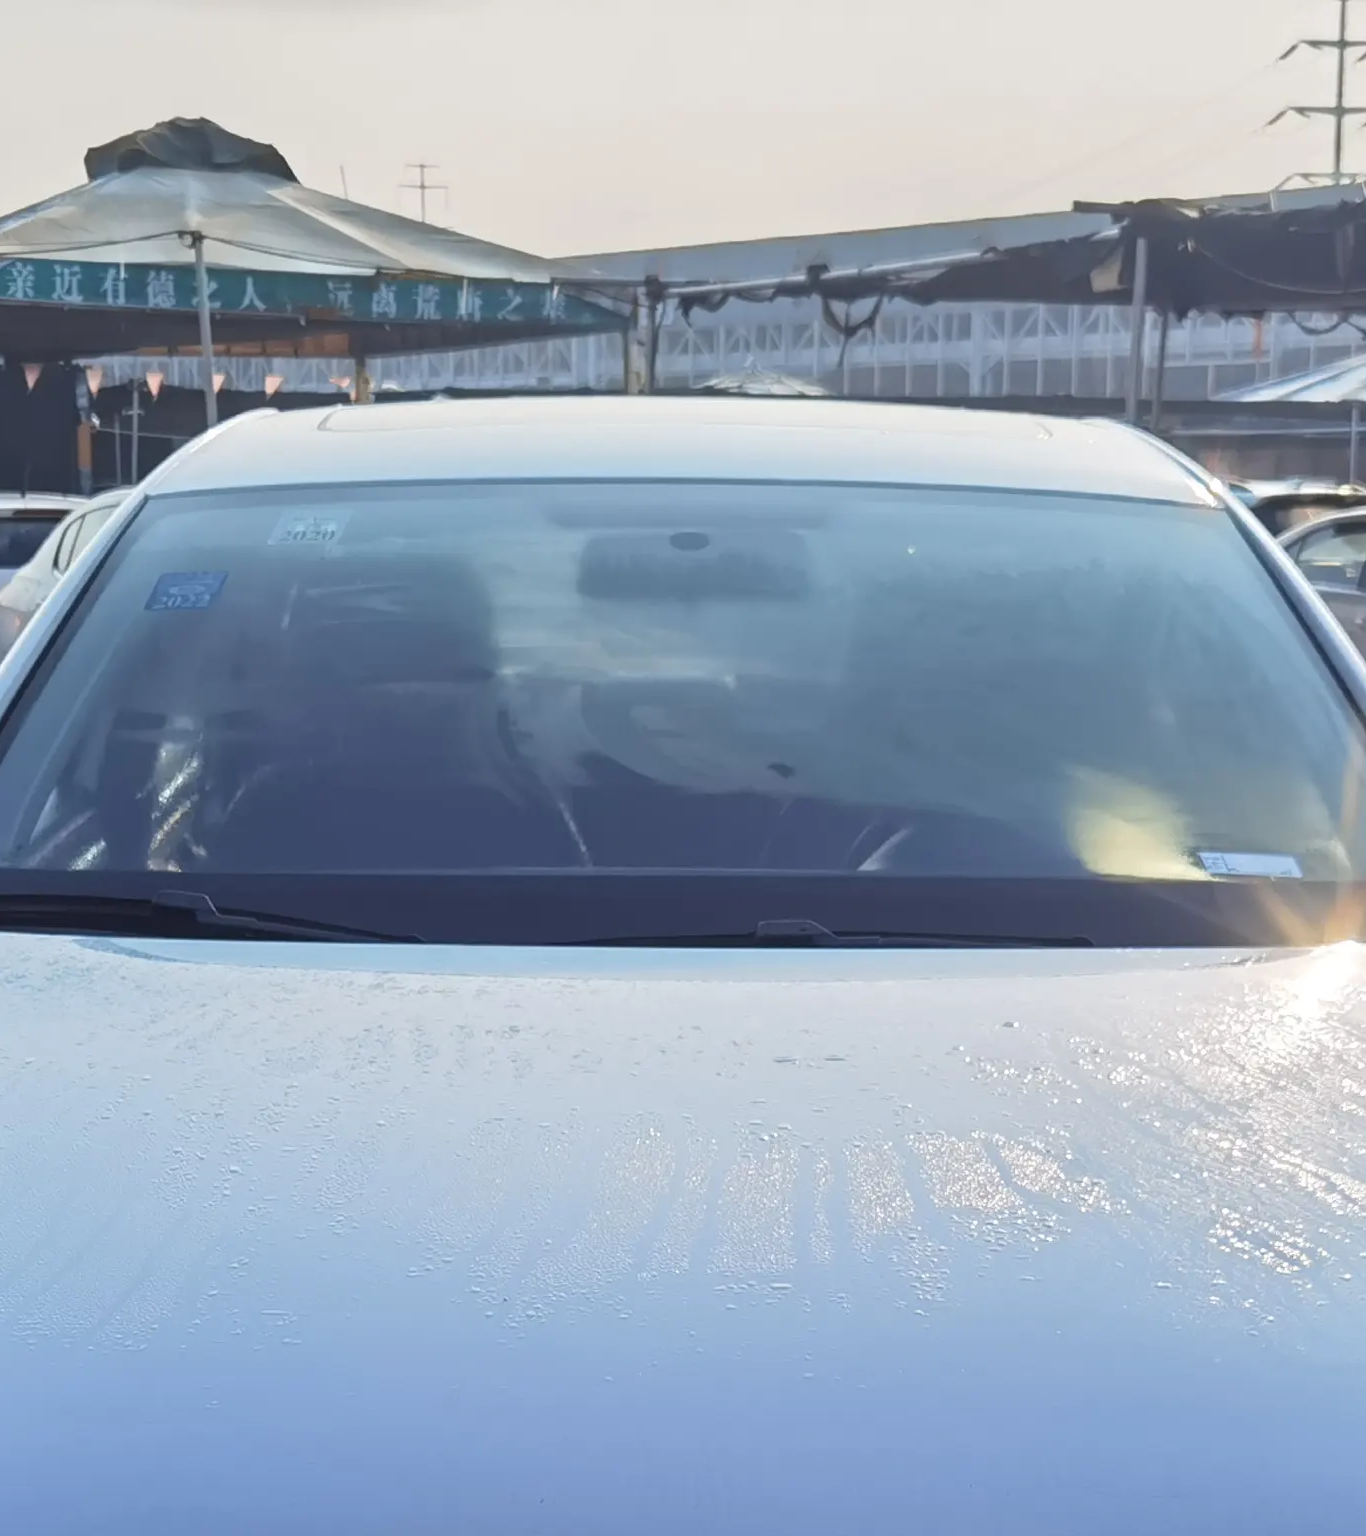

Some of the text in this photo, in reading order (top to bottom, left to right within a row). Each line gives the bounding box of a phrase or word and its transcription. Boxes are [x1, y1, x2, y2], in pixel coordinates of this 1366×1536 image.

[5, 261, 267, 312] 亲近有德之人
